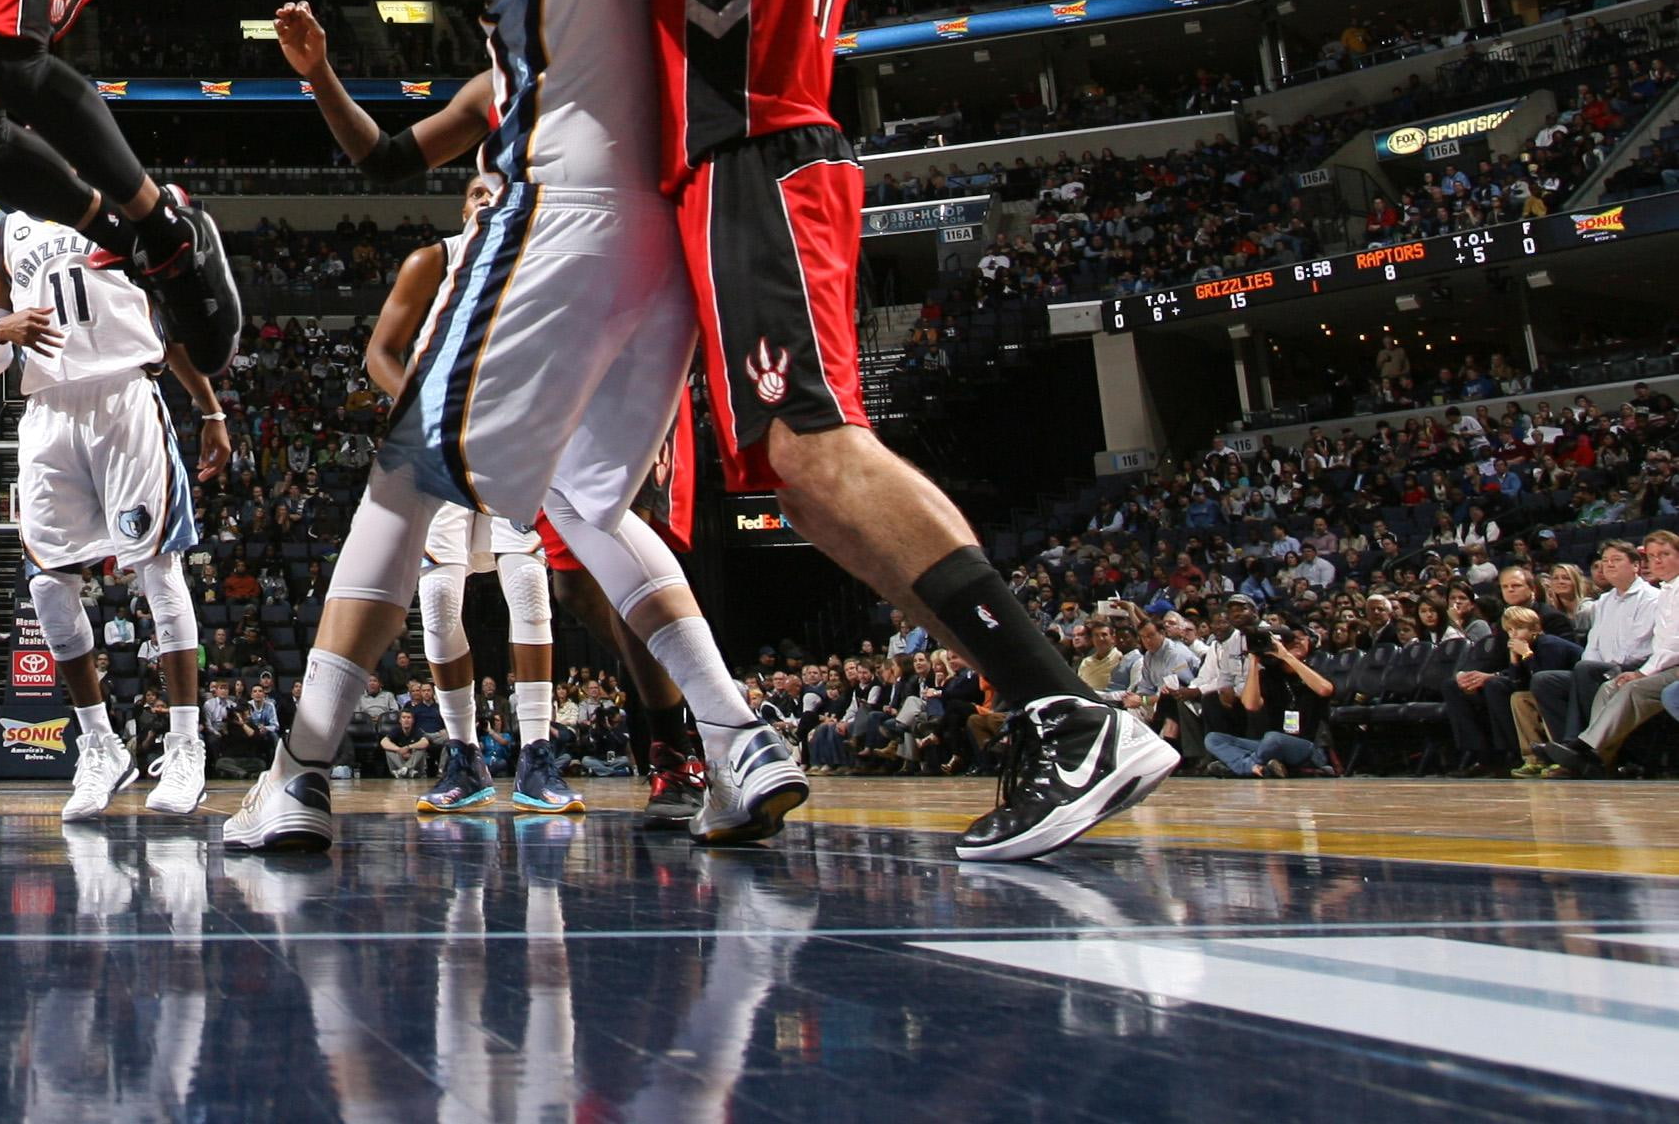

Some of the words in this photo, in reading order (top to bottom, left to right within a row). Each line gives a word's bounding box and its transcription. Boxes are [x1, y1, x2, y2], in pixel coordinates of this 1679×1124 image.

[1053, 4, 1085, 15] SONIC
[937, 21, 967, 32] SONIC
[835, 38, 856, 46] ONIC
[1396, 132, 1416, 144] FOX
[1429, 143, 1458, 156] 116A
[1302, 172, 1326, 185] 116A
[1575, 214, 1621, 231] SONIC
[946, 228, 971, 240] 116A
[15, 236, 98, 288] GRIZZLI
[1115, 301, 1121, 312] F
[1145, 292, 1177, 307] T.O.L
[1195, 272, 1273, 300] GRIZZLIES
[1356, 243, 1424, 269] RAPTORS
[1453, 231, 1493, 249] T.O.L
[1522, 222, 1530, 235] F
[1114, 314, 1123, 328] 0
[1153, 307, 1162, 321] 6
[1230, 293, 1247, 309] 15
[1384, 265, 1396, 280] 8
[1473, 247, 1485, 263] 5
[1523, 238, 1535, 254] 0
[49, 264, 93, 326] 11
[1234, 439, 1251, 451] 116
[1123, 454, 1138, 467] 116
[15, 674, 53, 683] TOYOTA
[6, 727, 64, 741] SONIC
